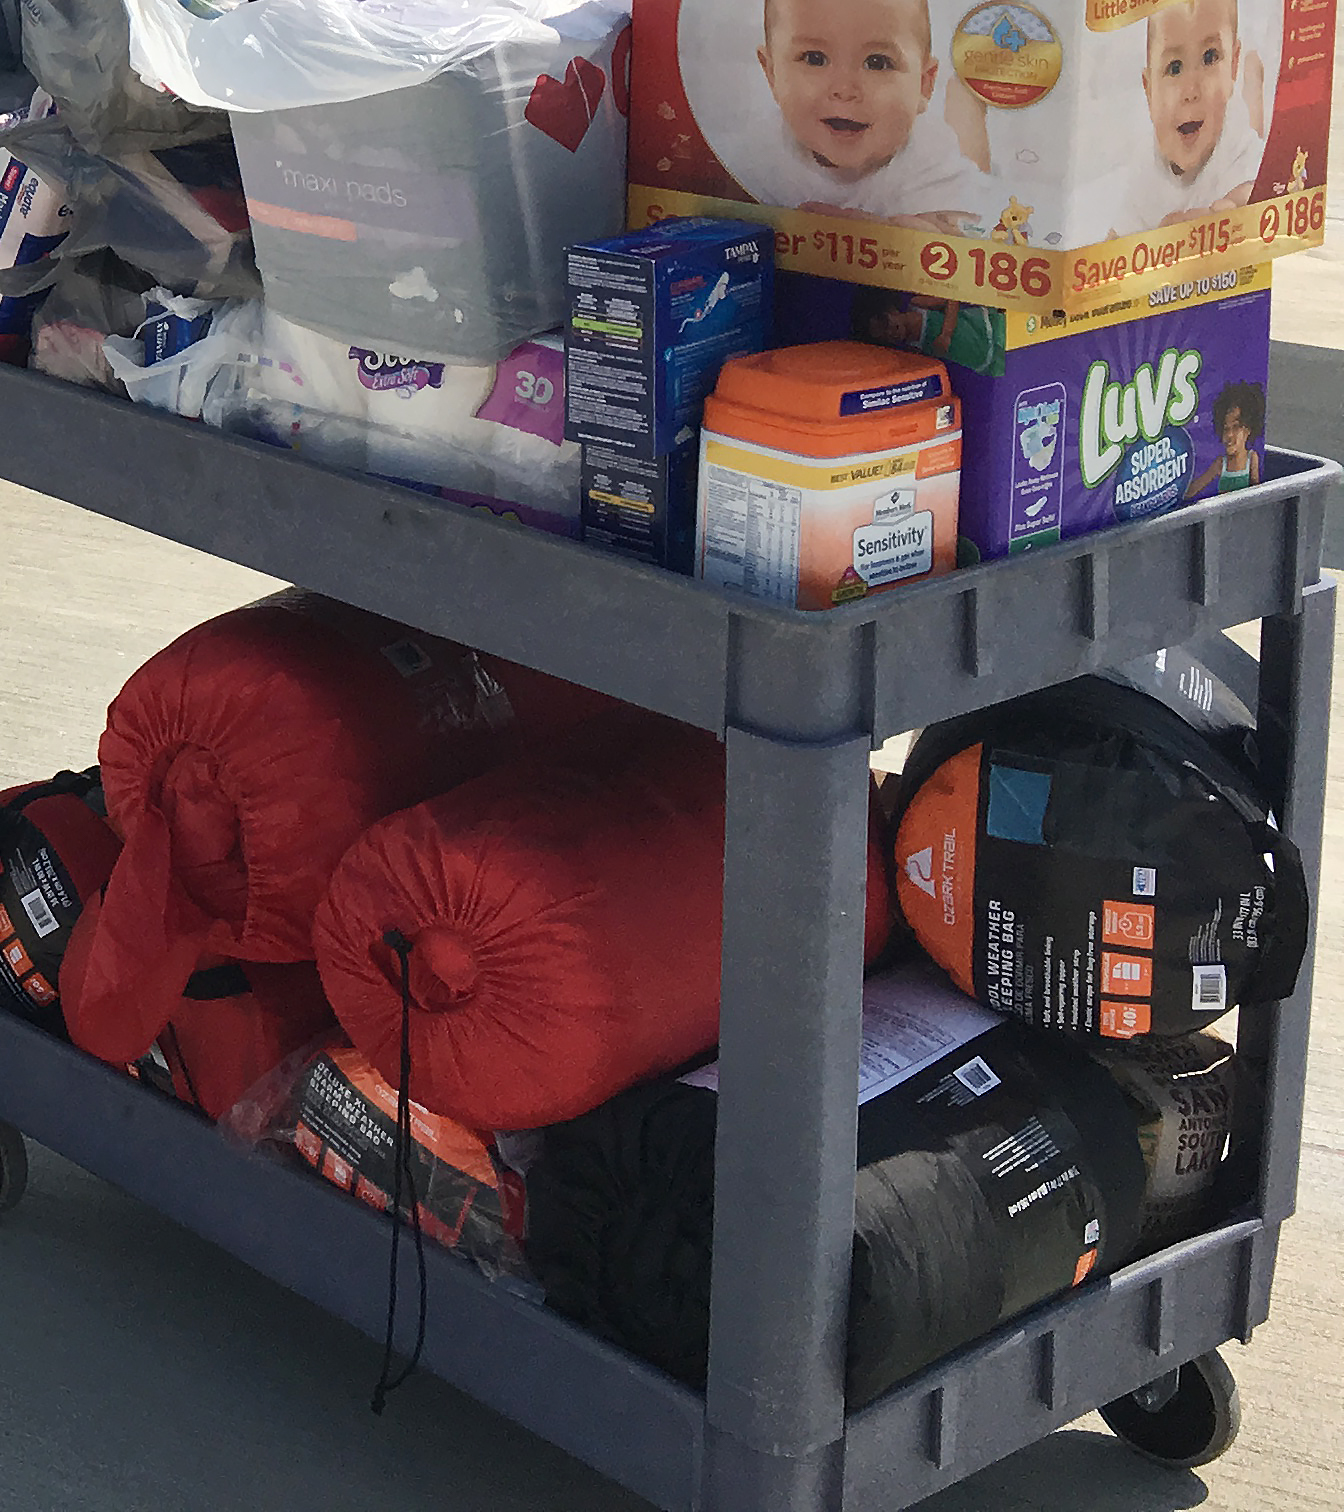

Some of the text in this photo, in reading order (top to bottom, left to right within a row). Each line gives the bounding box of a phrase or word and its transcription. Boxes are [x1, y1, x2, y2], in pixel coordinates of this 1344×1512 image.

[1018, 53, 1049, 69] skin
[19, 177, 39, 219] equate
[283, 168, 408, 208] maxi pads
[1284, 191, 1325, 237] 186
[775, 230, 878, 269] er $115
[1073, 257, 1127, 291] Save
[1131, 242, 1185, 275] Over
[1189, 219, 1231, 260] $115
[925, 244, 953, 277] 2
[968, 247, 1052, 297] 186
[1148, 284, 1178, 308] SAVE
[1179, 281, 1194, 300] UP
[1196, 277, 1210, 295] TO
[372, 365, 419, 389] Extra Soft
[515, 370, 554, 405] 30
[1131, 437, 1171, 476] SUPER
[1115, 452, 1188, 505] ABSORBENT
[857, 527, 925, 558] Sensitivity
[988, 900, 1003, 1010] OOL WEATHER
[1002, 910, 1014, 1010] EEPING BAG
[314, 1069, 342, 1102] WARM
[346, 1100, 394, 1147] WEATHER
[318, 1062, 367, 1114] DELUXE XL
[310, 1078, 356, 1125] SLEEPING
[360, 1124, 380, 1146] BAG
[1177, 1131, 1222, 1152] SOUT
[1174, 1149, 1215, 1176] LAK
